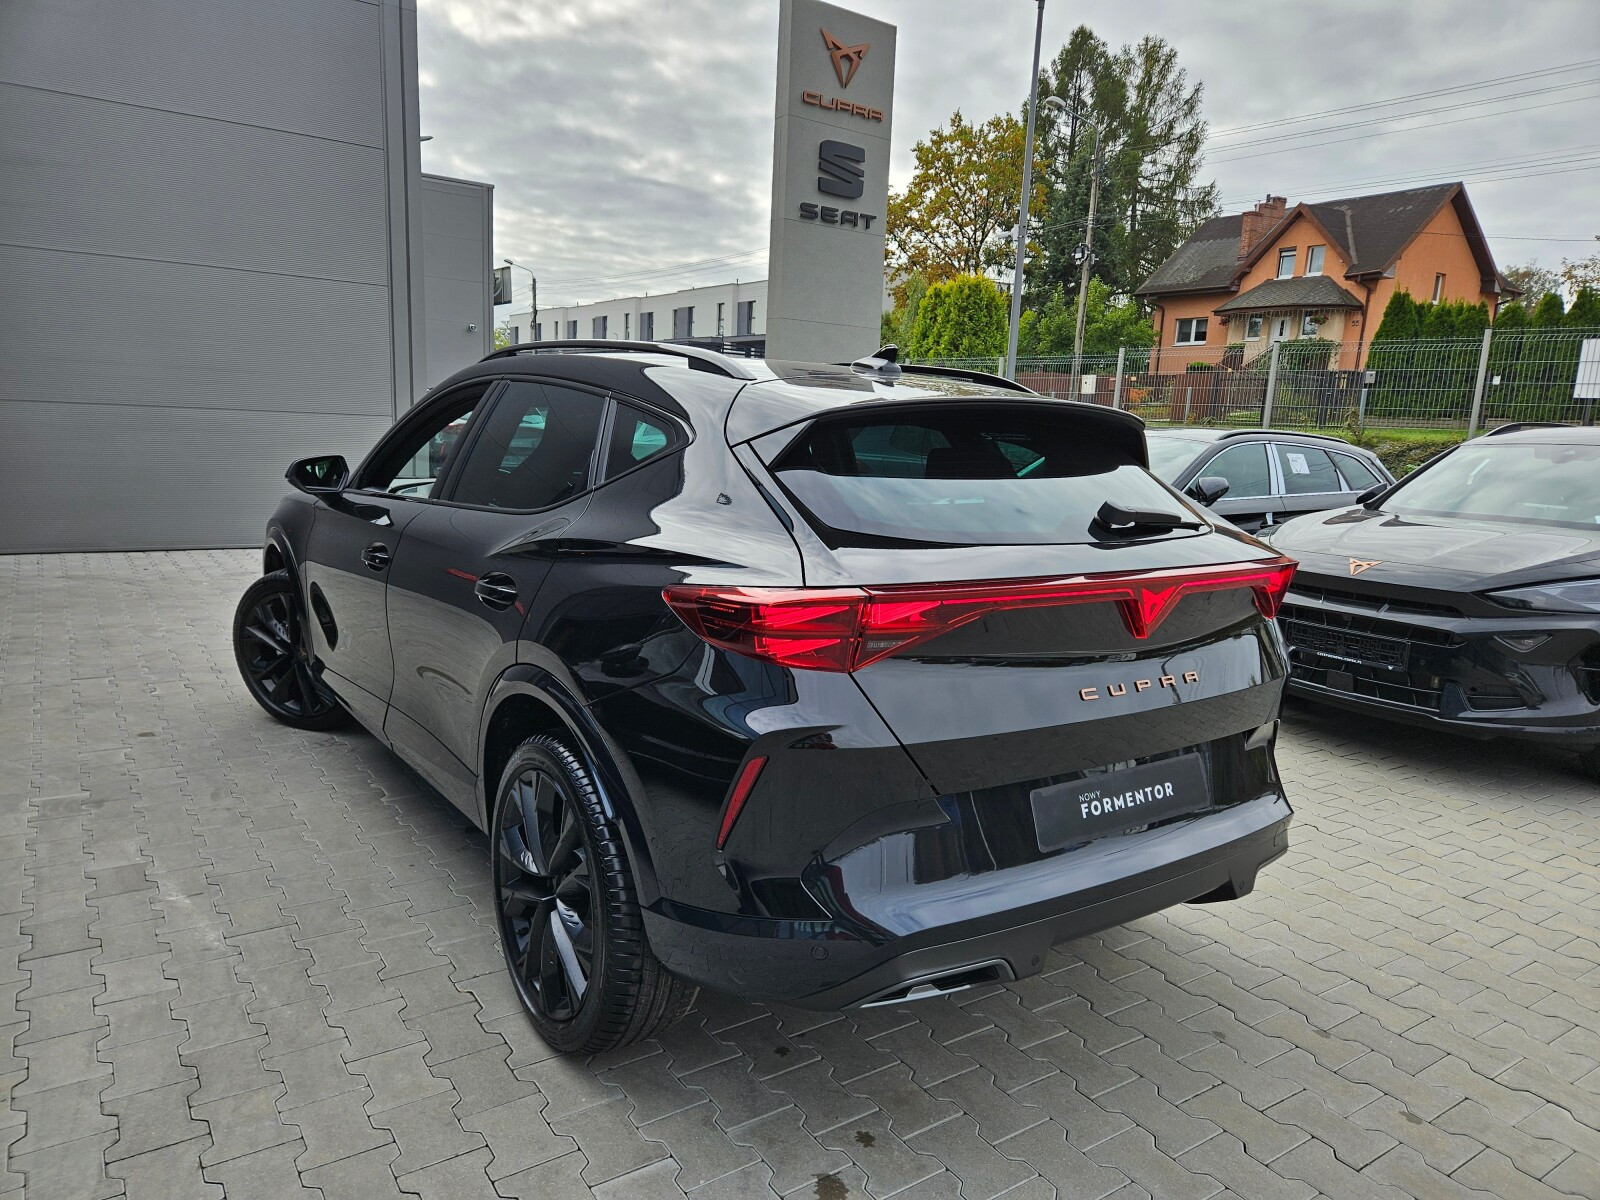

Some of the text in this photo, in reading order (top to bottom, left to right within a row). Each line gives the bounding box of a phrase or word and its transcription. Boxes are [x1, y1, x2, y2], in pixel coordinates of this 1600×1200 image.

[802, 90, 884, 122] CUPRA
[799, 202, 877, 230] SEAT
[1079, 670, 1199, 701] CUPRA
[1078, 789, 1101, 802] NOWY
[1080, 782, 1174, 819] FORMENTOR
